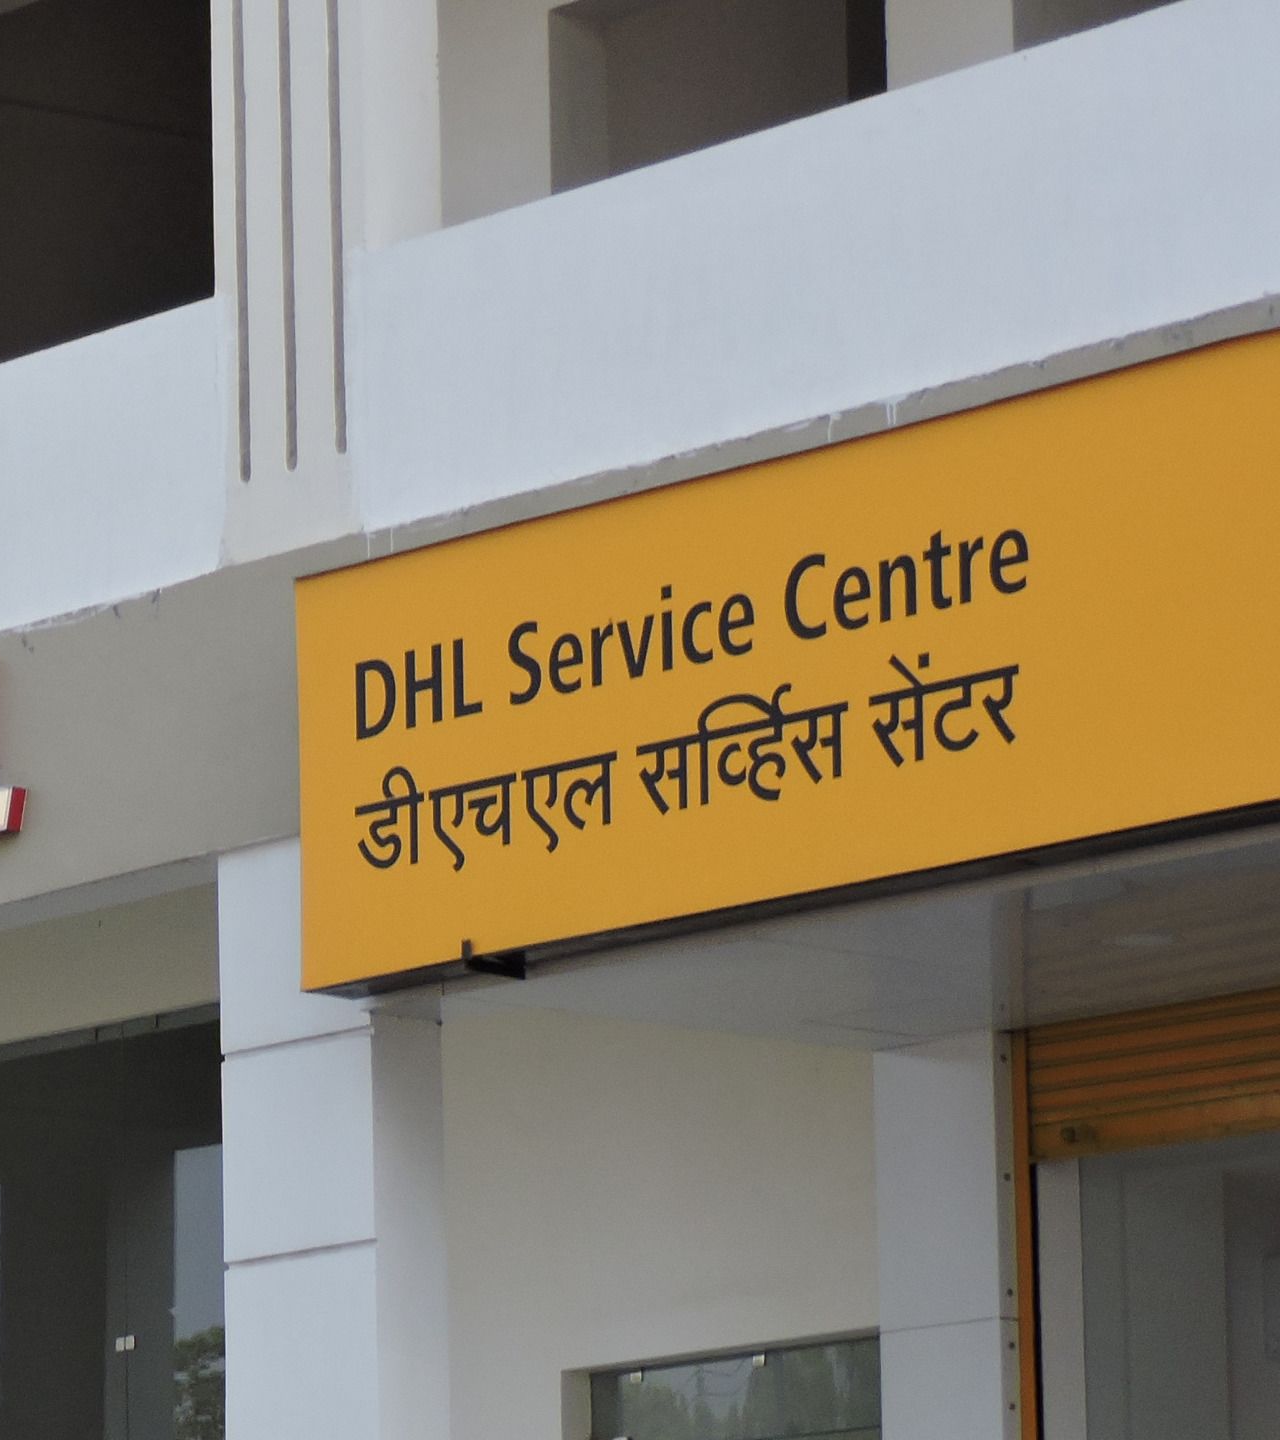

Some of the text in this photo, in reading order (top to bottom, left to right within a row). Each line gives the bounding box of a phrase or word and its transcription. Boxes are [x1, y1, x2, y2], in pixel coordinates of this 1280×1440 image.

[355, 527, 1030, 740] DHL Service Centre
[354, 742, 618, 872] डीएचएल
[868, 652, 1020, 768] सेंटर
